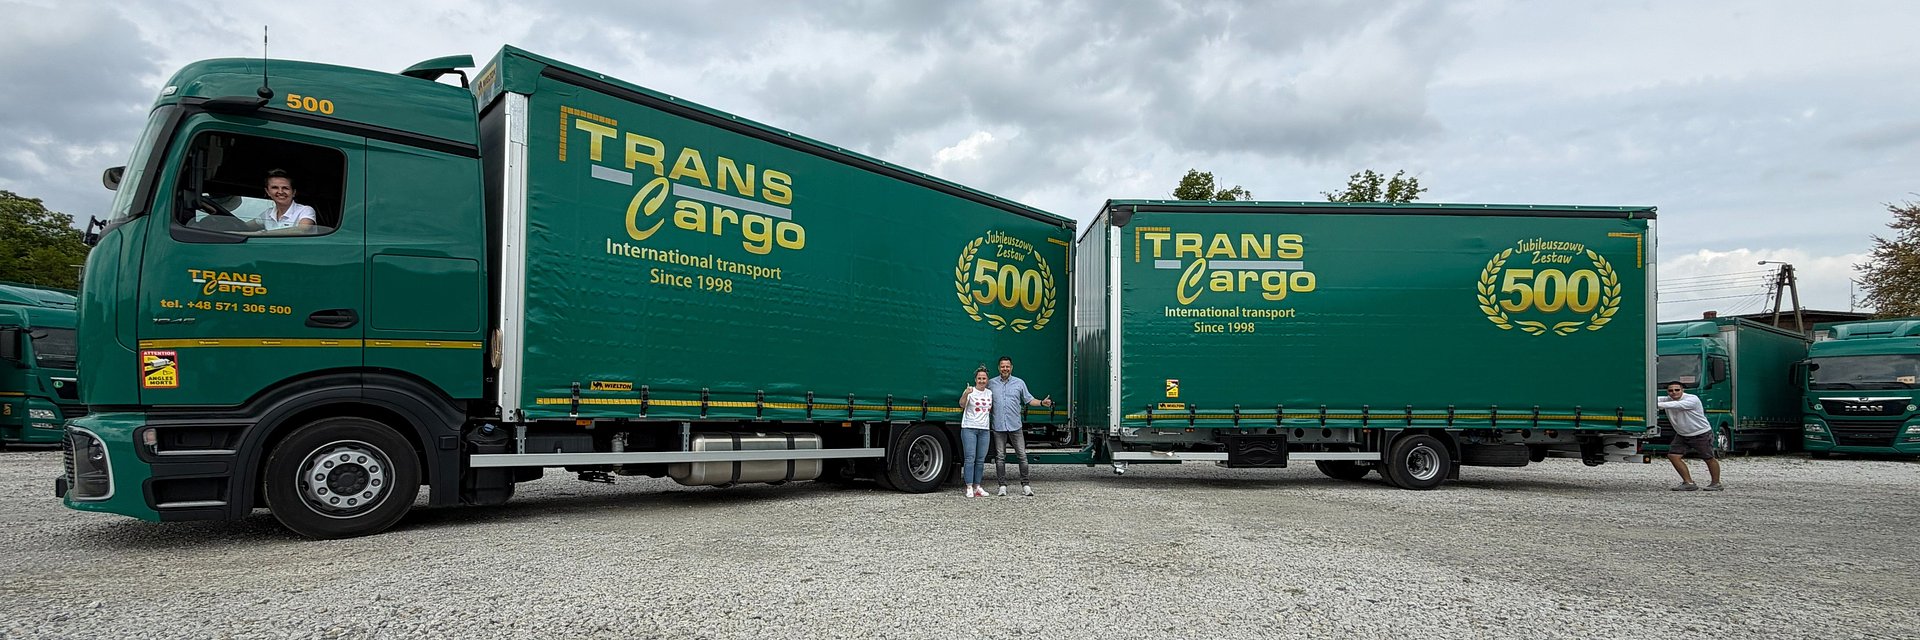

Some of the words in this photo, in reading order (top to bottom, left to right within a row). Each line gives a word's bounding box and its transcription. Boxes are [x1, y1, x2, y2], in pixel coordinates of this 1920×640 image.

[286, 93, 334, 115] 500
[575, 118, 793, 205] TRANS
[625, 176, 806, 255] Cargo
[985, 230, 1034, 254] Jubileuszowy
[996, 244, 1026, 262] Zestaw
[1144, 233, 1304, 259] TRANS
[1515, 237, 1585, 255] Jubileuszowy
[606, 237, 713, 270] International
[717, 254, 782, 280] transport
[1531, 251, 1573, 265] Zestaw
[188, 269, 262, 283] TRANS
[650, 268, 693, 289] Since
[697, 275, 733, 293] 1998
[972, 258, 1043, 312] 500
[1176, 257, 1316, 306] Cargo
[203, 279, 268, 297] Cargo
[1499, 268, 1600, 314] 500
[160, 299, 183, 309] tel.
[187, 300, 212, 310] +48
[215, 302, 238, 312] 571
[243, 303, 266, 313] 306
[269, 305, 292, 315] 500
[1165, 306, 1239, 318] International
[1242, 307, 1296, 320] transport
[1194, 322, 1225, 333] Since
[1228, 322, 1255, 333] 1998
